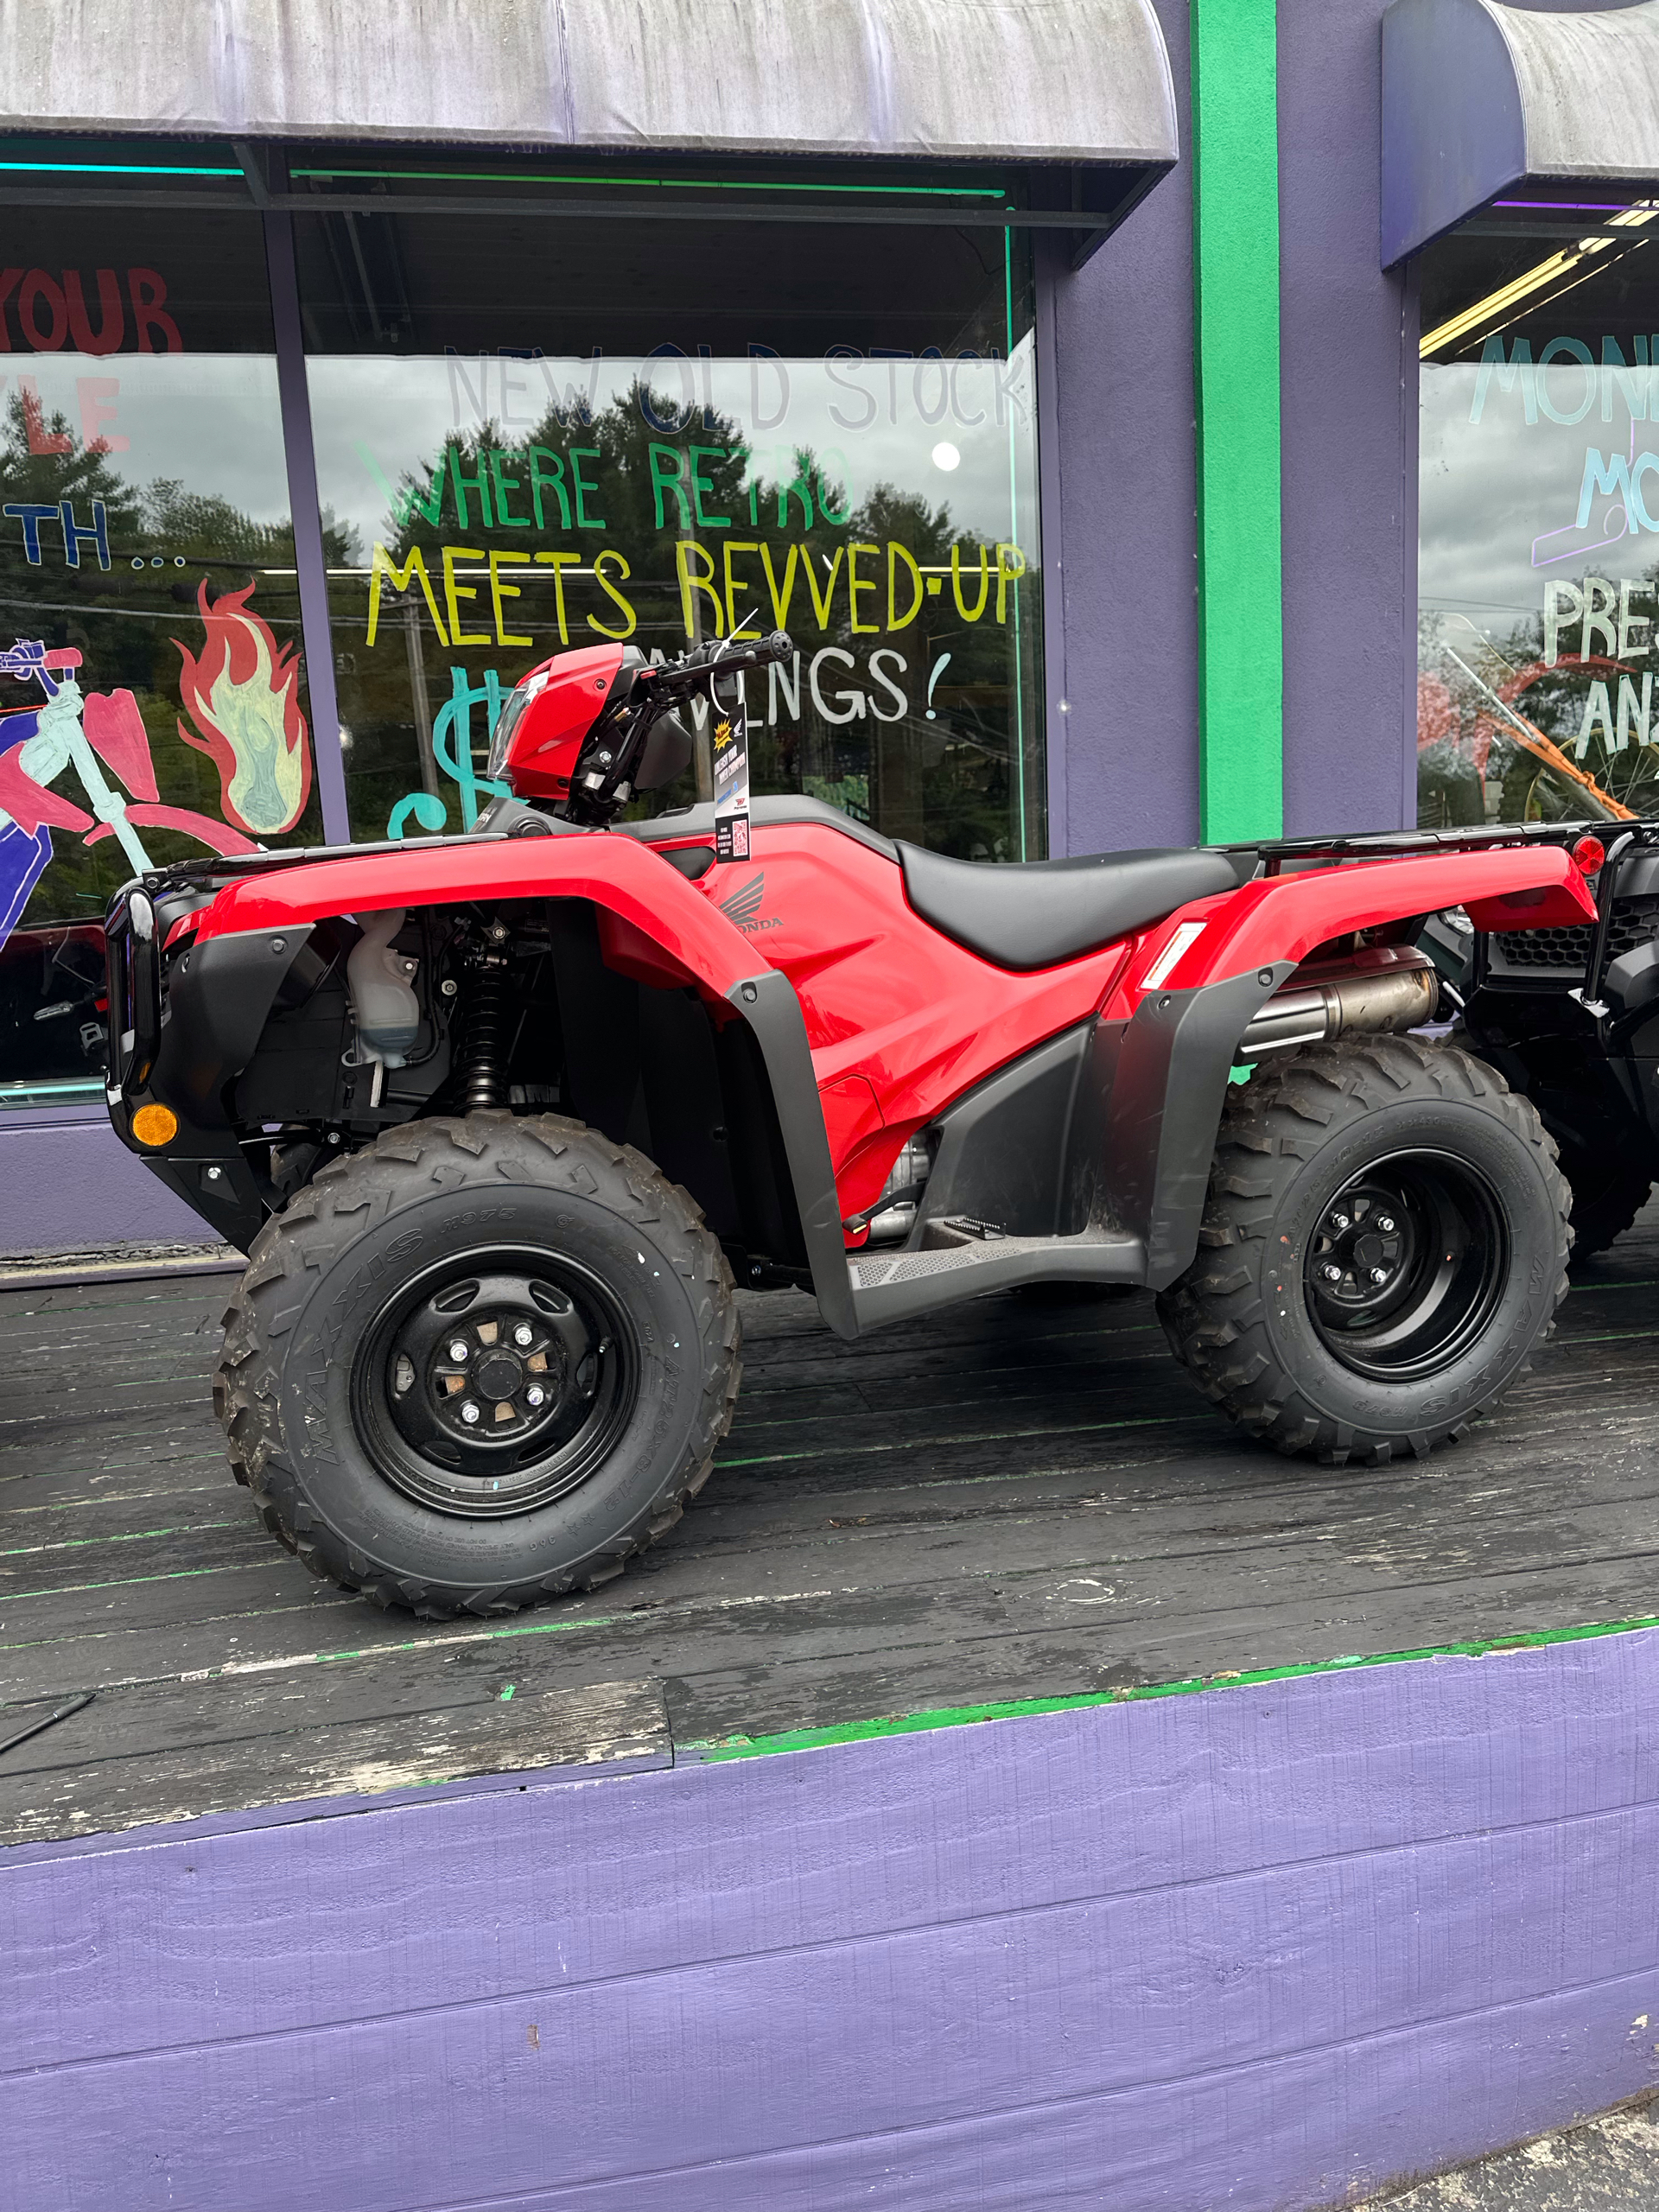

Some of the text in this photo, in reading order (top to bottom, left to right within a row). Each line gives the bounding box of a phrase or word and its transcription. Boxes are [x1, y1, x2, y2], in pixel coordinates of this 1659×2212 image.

[0, 374, 130, 455] LE
[444, 342, 1033, 435] NEW OLD STOCK
[1469, 335, 1659, 425] MON
[354, 440, 855, 531] WHERE RETRO
[365, 540, 638, 648] MEETS
[1543, 577, 1659, 668] PRE
[1574, 671, 1659, 760] AN
[737, 917, 784, 934] ONDA
[440, 1207, 518, 1234] M975
[304, 1228, 423, 1466] MAXXIS
[1420, 1255, 1544, 1416] MAXXIS
